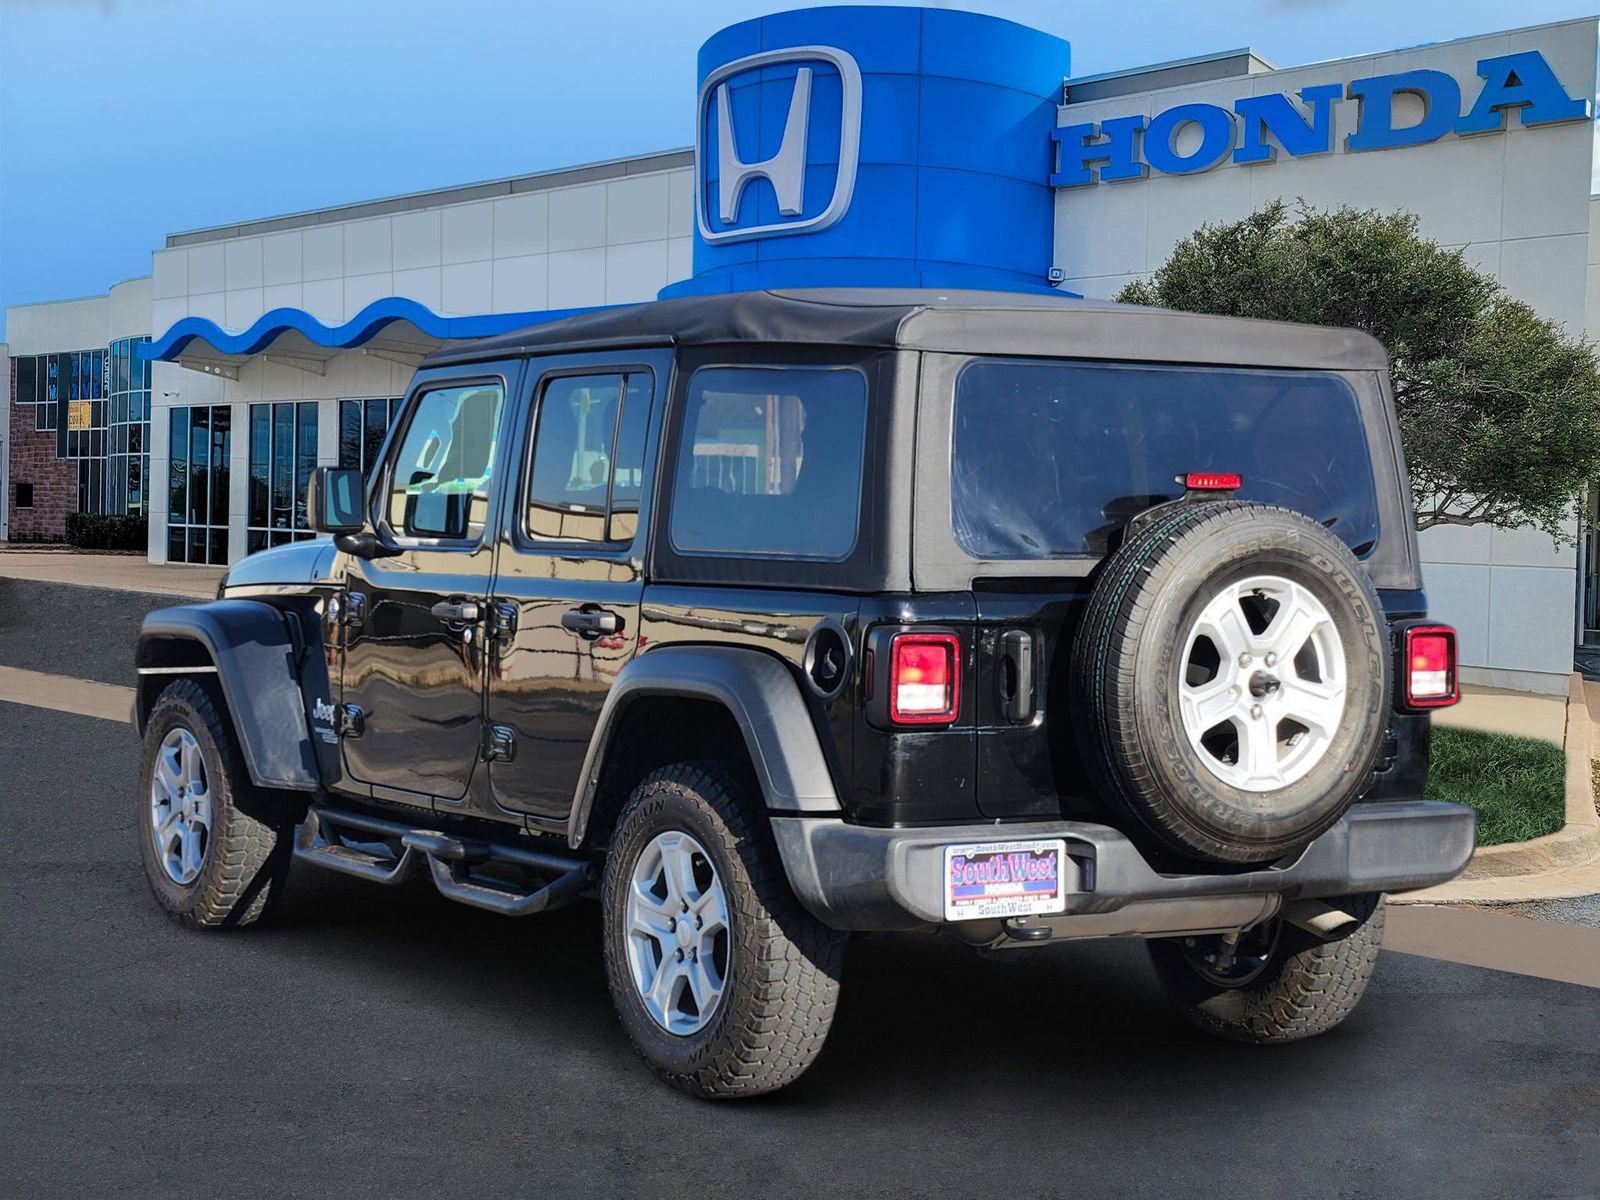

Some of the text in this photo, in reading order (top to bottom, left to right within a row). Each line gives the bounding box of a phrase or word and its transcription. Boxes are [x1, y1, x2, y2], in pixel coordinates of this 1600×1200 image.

[1050, 50, 1592, 188] HONDA
[952, 842, 1058, 855] wwwSouthWestHondacom
[951, 852, 1057, 886] SouthWest
[978, 902, 1032, 916] SouthWest
